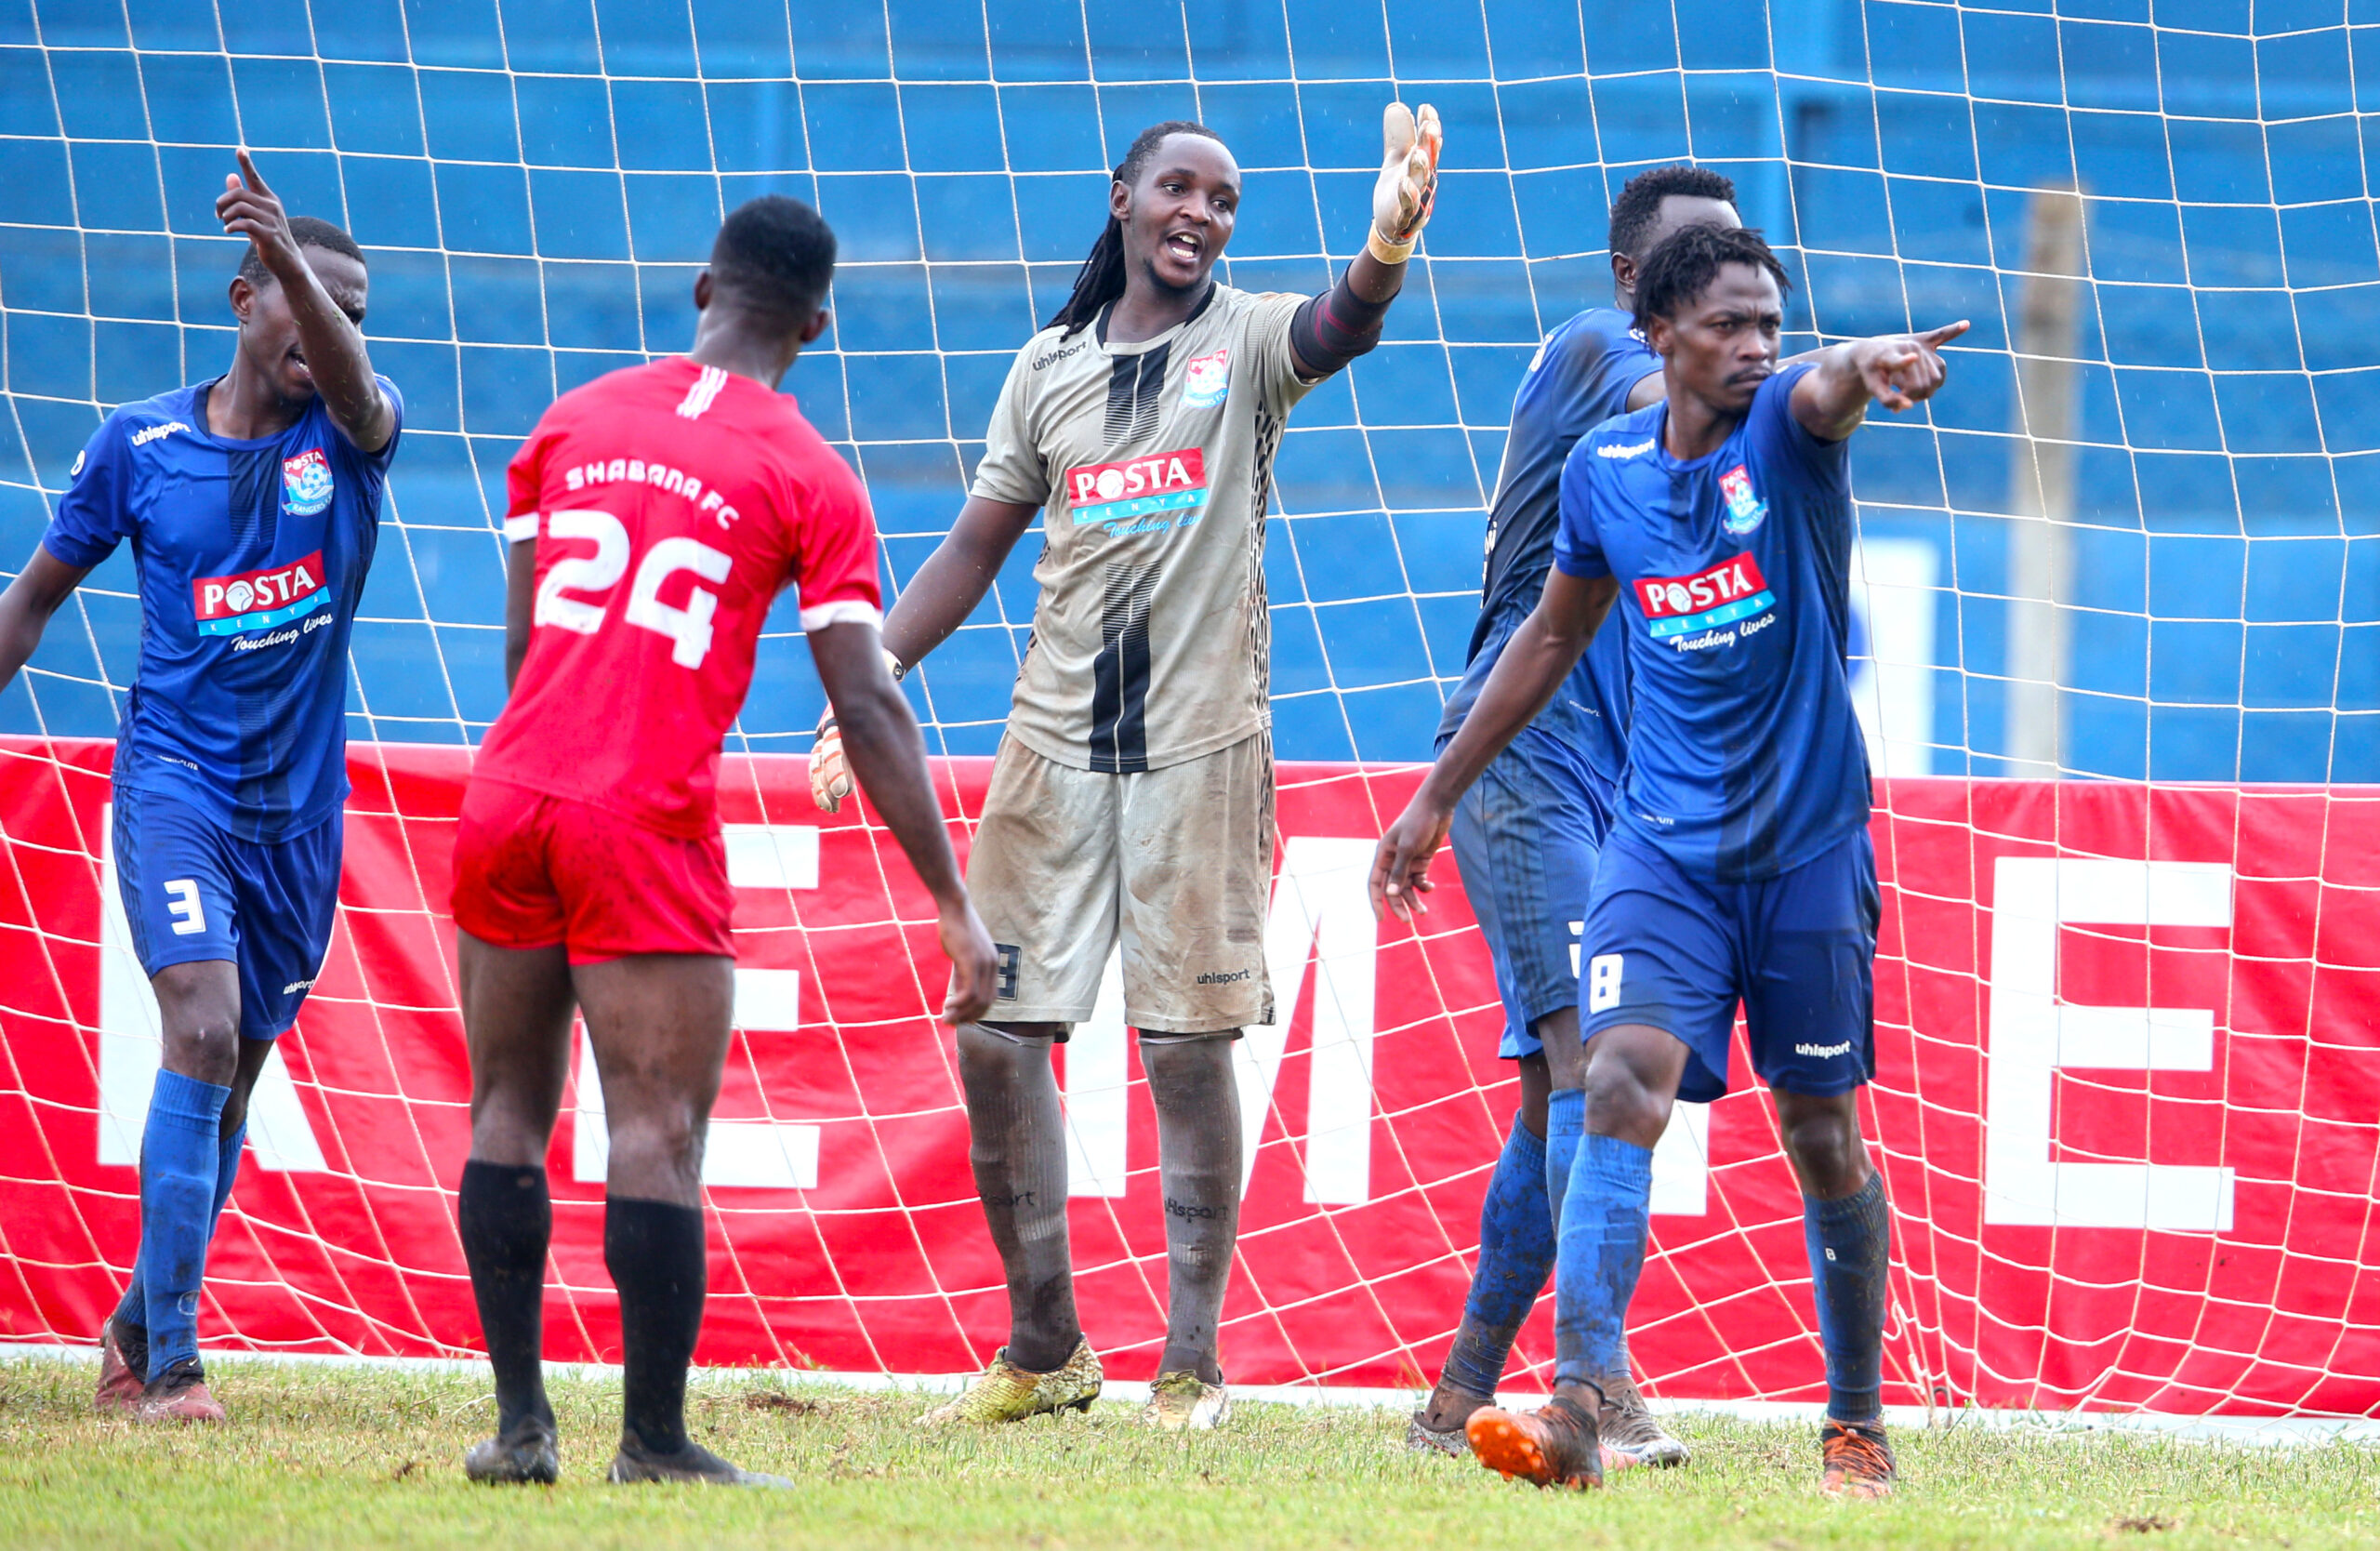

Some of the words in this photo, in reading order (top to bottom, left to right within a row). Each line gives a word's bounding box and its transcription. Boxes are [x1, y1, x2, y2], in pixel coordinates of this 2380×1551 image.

[1032, 341, 1087, 371] uhlsport
[284, 451, 324, 472] POSTA
[1075, 457, 1193, 503] POSTA
[565, 458, 702, 501] SHABANA
[701, 490, 740, 530] FC
[1082, 494, 1196, 520] KENYA
[1103, 517, 1171, 538] Touching
[204, 564, 317, 616] POSTA
[534, 509, 734, 670] 24
[1645, 563, 1754, 614] POSTA
[210, 596, 320, 632] KENYA
[231, 629, 300, 652] Touching
[302, 613, 334, 635] lives
[1659, 599, 1765, 632] KENYA
[1669, 629, 1737, 653] Touching
[1739, 613, 1776, 637] lives
[163, 879, 207, 936] 3
[1197, 968, 1250, 986] uhlsport
[1589, 953, 1625, 1015] 8
[1794, 1039, 1852, 1060] uhlsport
